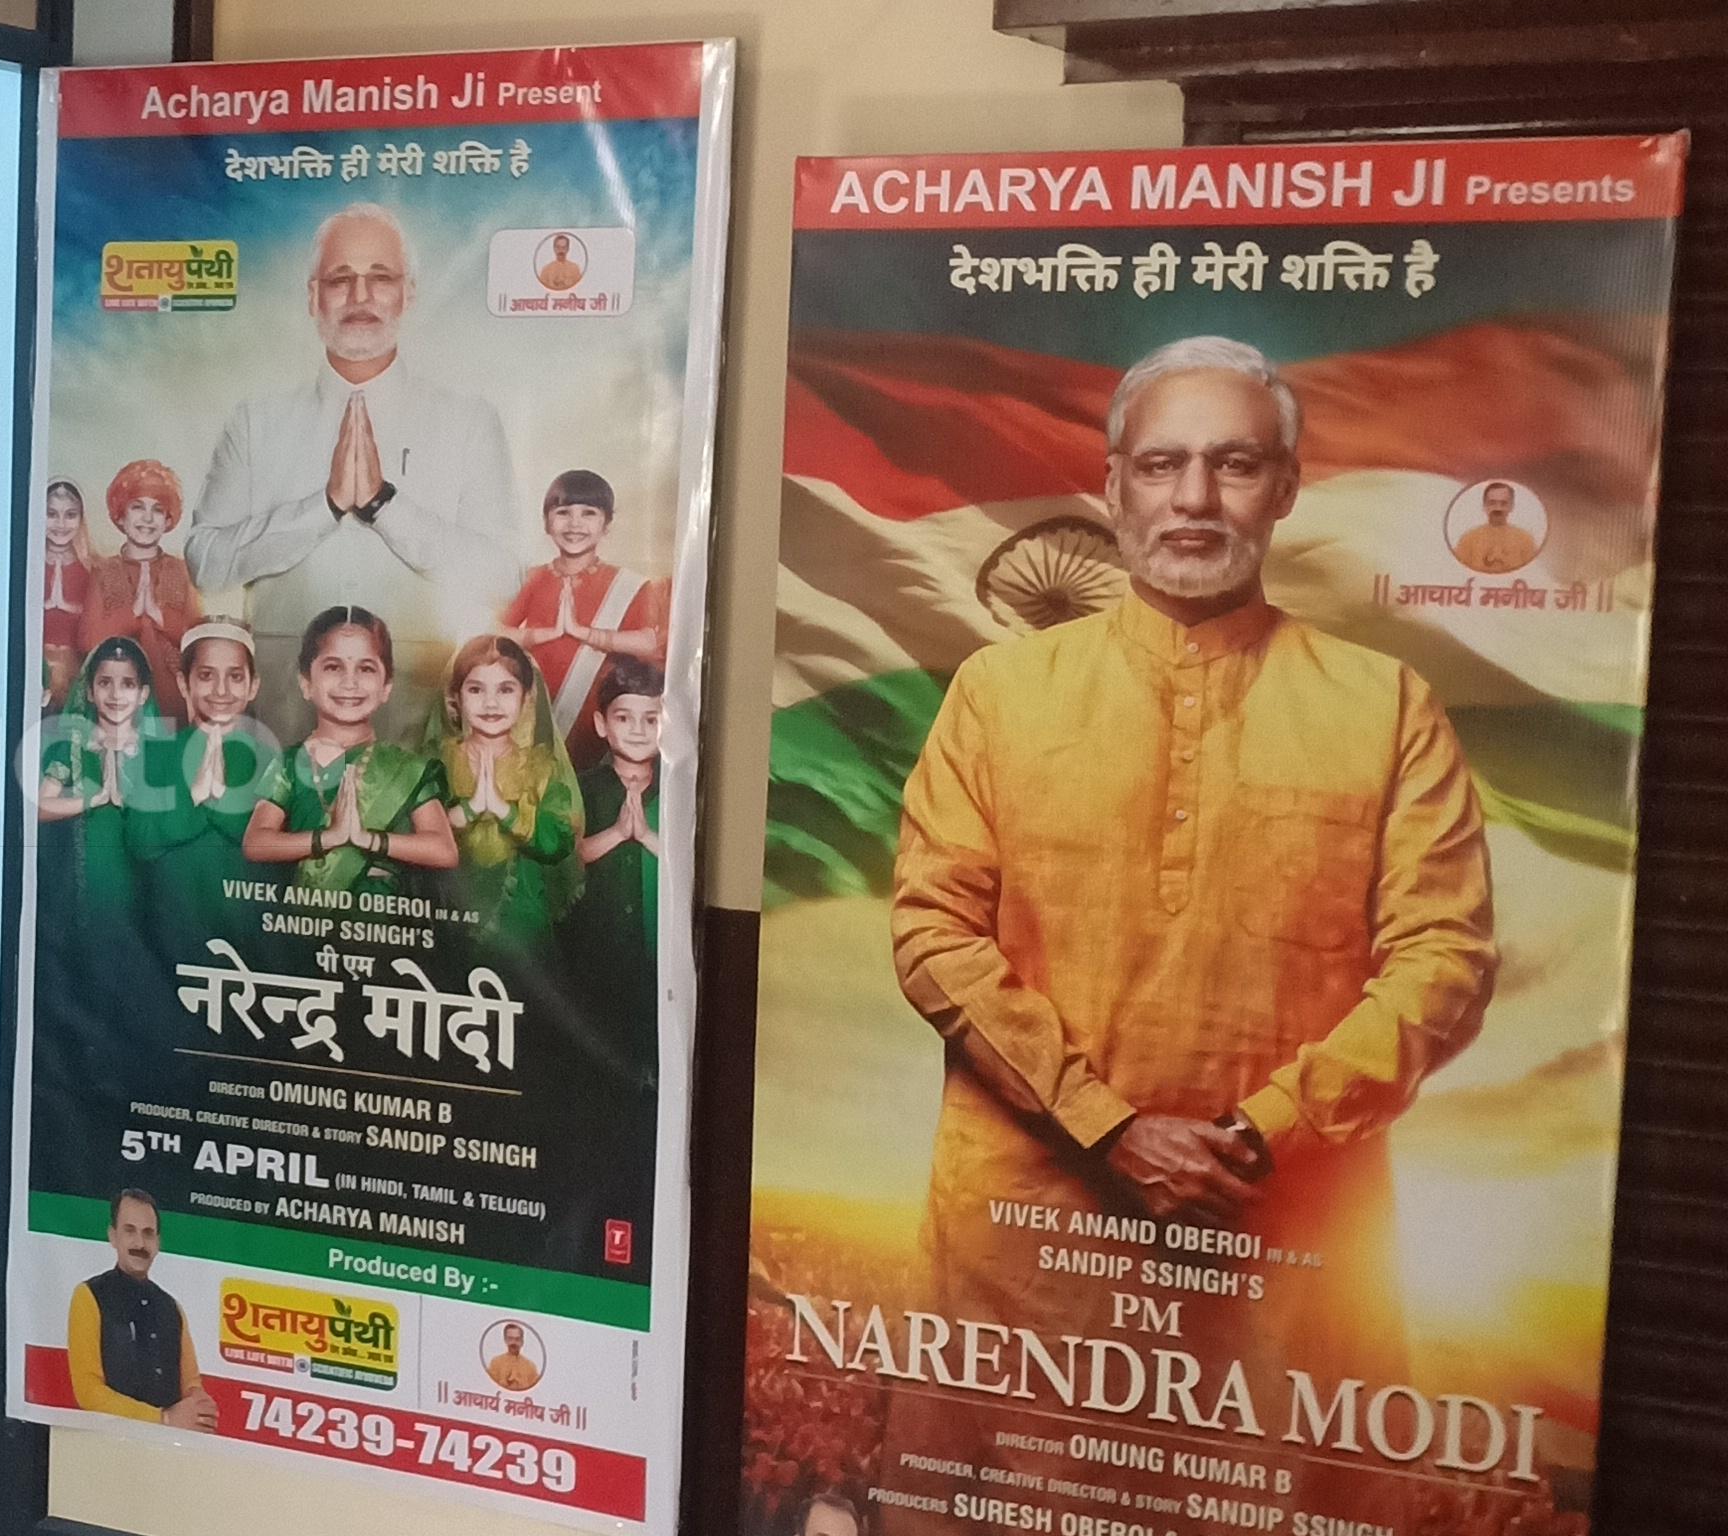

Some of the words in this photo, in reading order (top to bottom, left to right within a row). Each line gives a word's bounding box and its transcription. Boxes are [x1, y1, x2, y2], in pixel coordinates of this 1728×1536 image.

[141, 83, 290, 125] Acharya
[302, 76, 438, 115] Manish
[451, 72, 485, 108] Ji
[498, 80, 602, 107] Present
[225, 149, 332, 183] देशभक्ति
[341, 145, 369, 179] ही
[377, 142, 423, 177] मेरी
[434, 142, 501, 176] शक्ति
[510, 138, 531, 177] है
[831, 169, 1111, 215] ACHARYA
[1130, 162, 1372, 211] MANISH
[1392, 158, 1445, 208] JI
[1466, 174, 1635, 206] Presents
[950, 246, 1119, 292] देशभक्ति
[1132, 245, 1179, 292] ही
[1192, 242, 1266, 292] मेरी
[1281, 241, 1389, 292] शक्ति
[1405, 239, 1439, 296] है
[1554, 582, 1587, 610] जी
[222, 880, 277, 903] VIVEK
[282, 885, 353, 911] ANAND
[359, 892, 431, 918] OBEROI
[262, 912, 334, 938] SANDIP
[340, 919, 434, 948] SSINGH'S
[316, 945, 339, 972] पी
[344, 954, 374, 978] एम
[176, 939, 343, 1062] नरेन्द्र
[363, 959, 523, 1072] मोदी
[209, 1081, 265, 1099] DIRECTOR
[269, 1081, 347, 1110] OMUNG
[354, 1091, 431, 1120] KUMAR
[438, 1103, 452, 1124] B
[131, 1102, 192, 1122] PRODUCER,
[196, 1113, 249, 1129] CREATIVE
[252, 1118, 308, 1136] DIRECTOR
[311, 1126, 320, 1138] &
[324, 1128, 362, 1144] STORY
[366, 1126, 445, 1155] SANDIP
[453, 1137, 537, 1169] SSINGH
[121, 1130, 180, 1162] 5TH
[194, 1141, 329, 1189] APRIL
[335, 1173, 356, 1191] (IN
[362, 1176, 407, 1199] HINDI,
[412, 1184, 458, 1204] TAMIL
[463, 1193, 474, 1207] &
[479, 1193, 546, 1221] TELUGU)
[191, 1193, 251, 1212] PRODUCED
[255, 1201, 269, 1215] BY
[275, 1198, 372, 1230] ACHARYA
[380, 1213, 465, 1244] MANISH
[989, 1200, 1060, 1233] VIVEK
[1068, 1211, 1157, 1245] ANAND
[1165, 1224, 1261, 1258] OBEROI
[330, 1248, 437, 1285] Produced
[445, 1267, 475, 1294] By
[1039, 1246, 1133, 1282] SANDIP
[1141, 1260, 1265, 1300] SSINGH'S
[1111, 1290, 1182, 1337] PM
[550, 1404, 571, 1425] जी
[786, 1294, 1265, 1438] NARENDRA
[1282, 1369, 1544, 1483] MODI
[241, 1391, 576, 1493] 74239-74239
[996, 1431, 1064, 1455] DIRECTOR
[1070, 1434, 1165, 1472] OMUNG
[1173, 1452, 1267, 1489] KUMAR
[1275, 1470, 1292, 1493] B
[868, 1488, 949, 1514] PRODUCERS
[954, 1494, 1052, 1533] SURESH
[901, 1453, 975, 1480] PRODUCER,
[980, 1468, 1043, 1492] CREATIVE
[1048, 1480, 1116, 1502] DIRECTOR
[1136, 1493, 1182, 1514] STORY
[1186, 1494, 1283, 1531] SANDIP
